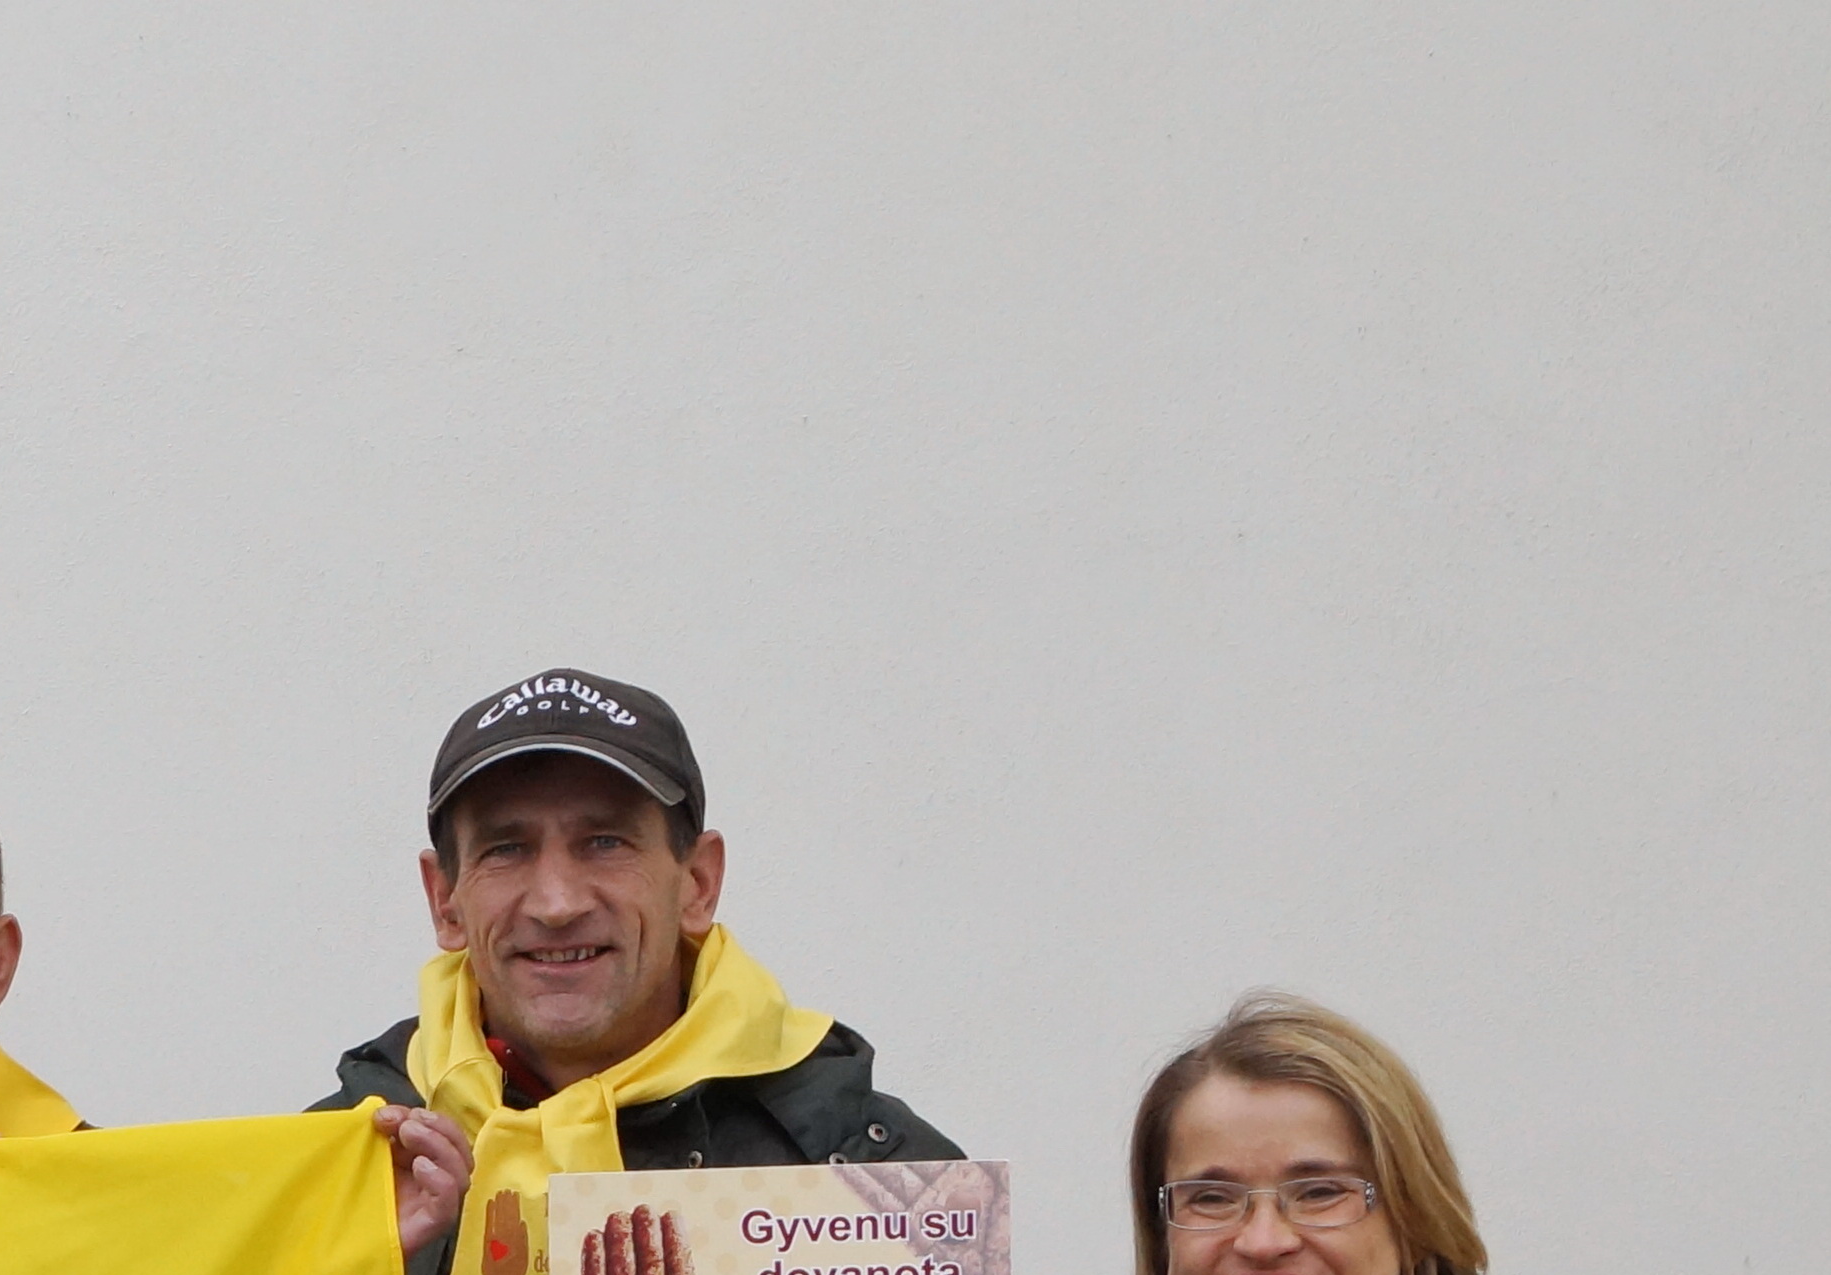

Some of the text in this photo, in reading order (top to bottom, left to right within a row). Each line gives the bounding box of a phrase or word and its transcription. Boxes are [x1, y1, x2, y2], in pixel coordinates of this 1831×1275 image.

[477, 676, 637, 730] Callaway
[516, 699, 589, 716] GOLF
[742, 1211, 973, 1252] Gyvenu su
